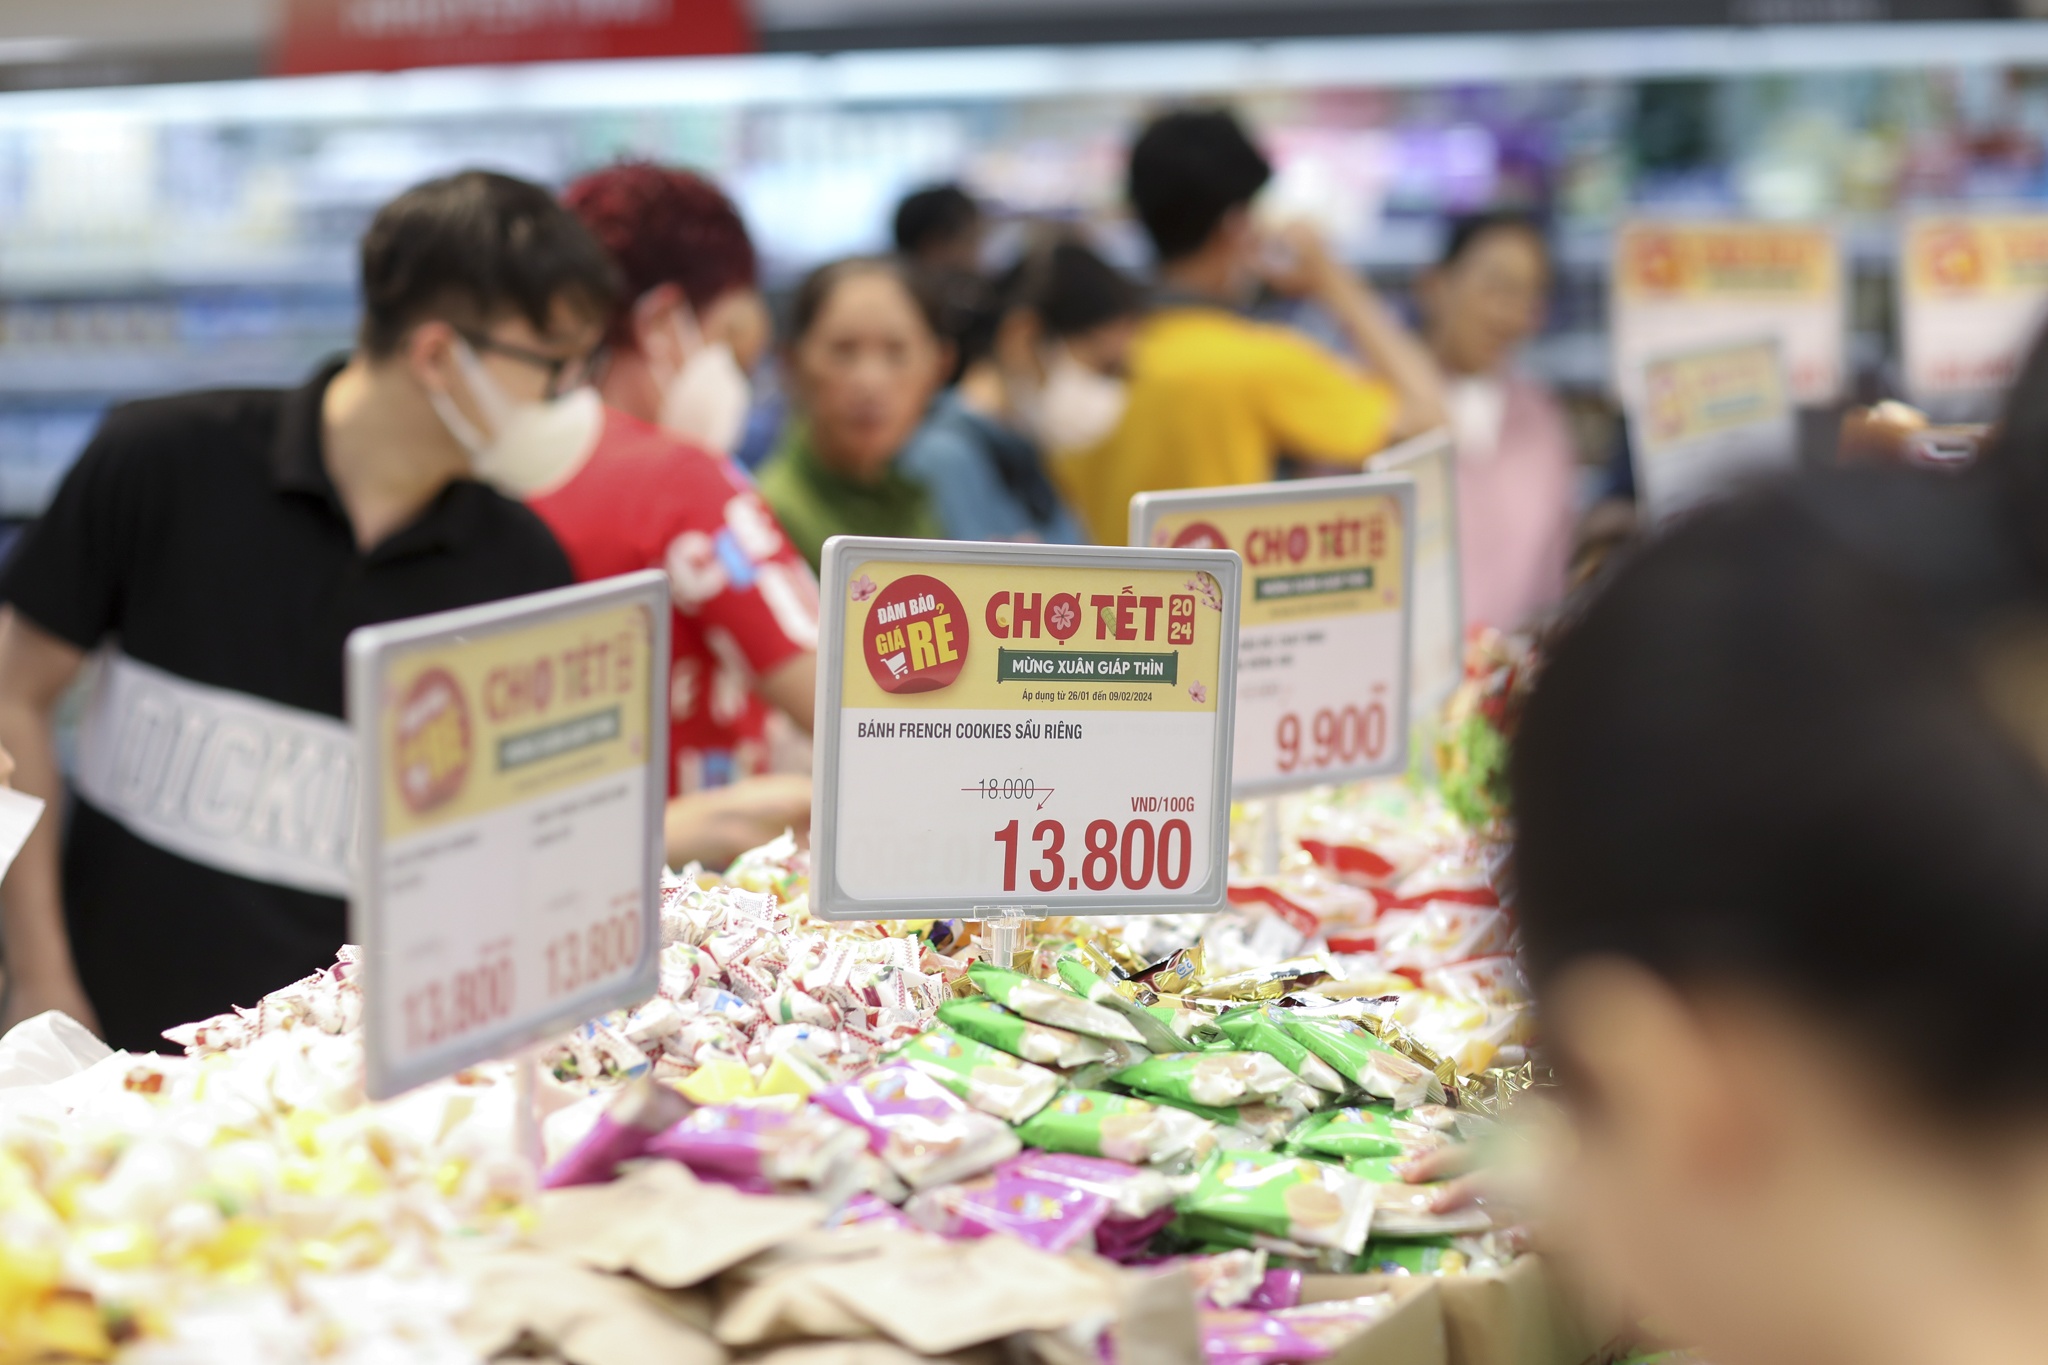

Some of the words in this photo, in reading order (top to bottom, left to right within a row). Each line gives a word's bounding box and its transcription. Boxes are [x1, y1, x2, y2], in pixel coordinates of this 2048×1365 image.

[877, 602, 907, 625] ĐẢM
[909, 593, 936, 616] BẢO
[985, 591, 1082, 645] CHỢ
[1090, 586, 1163, 641] TẾT
[1171, 599, 1193, 617] 20
[875, 625, 906, 655] GIÁ
[907, 603, 959, 671] RẺ
[1170, 622, 1192, 640] 24
[1012, 656, 1054, 674] MỪNG
[1057, 656, 1094, 675] XUÂN
[1097, 658, 1131, 675] GIÁP
[1133, 658, 1163, 675] THÌN
[1022, 689, 1033, 702] Áp
[1034, 690, 1055, 703] dụng
[1057, 690, 1067, 701] từ
[1068, 691, 1090, 701] 26/01
[1092, 689, 1107, 701] đến
[1108, 691, 1152, 702] 09/02/2024
[858, 719, 895, 738] BÁNH
[899, 723, 951, 739] FRENCH
[956, 723, 1011, 739] COOKIES
[1015, 719, 1041, 739] SẦU
[1044, 721, 1083, 739] RIÊNG
[1276, 700, 1387, 774] 9.900
[979, 778, 1034, 800] 18.000
[1131, 796, 1195, 812] VND/100G
[994, 818, 1192, 892] 13.800
